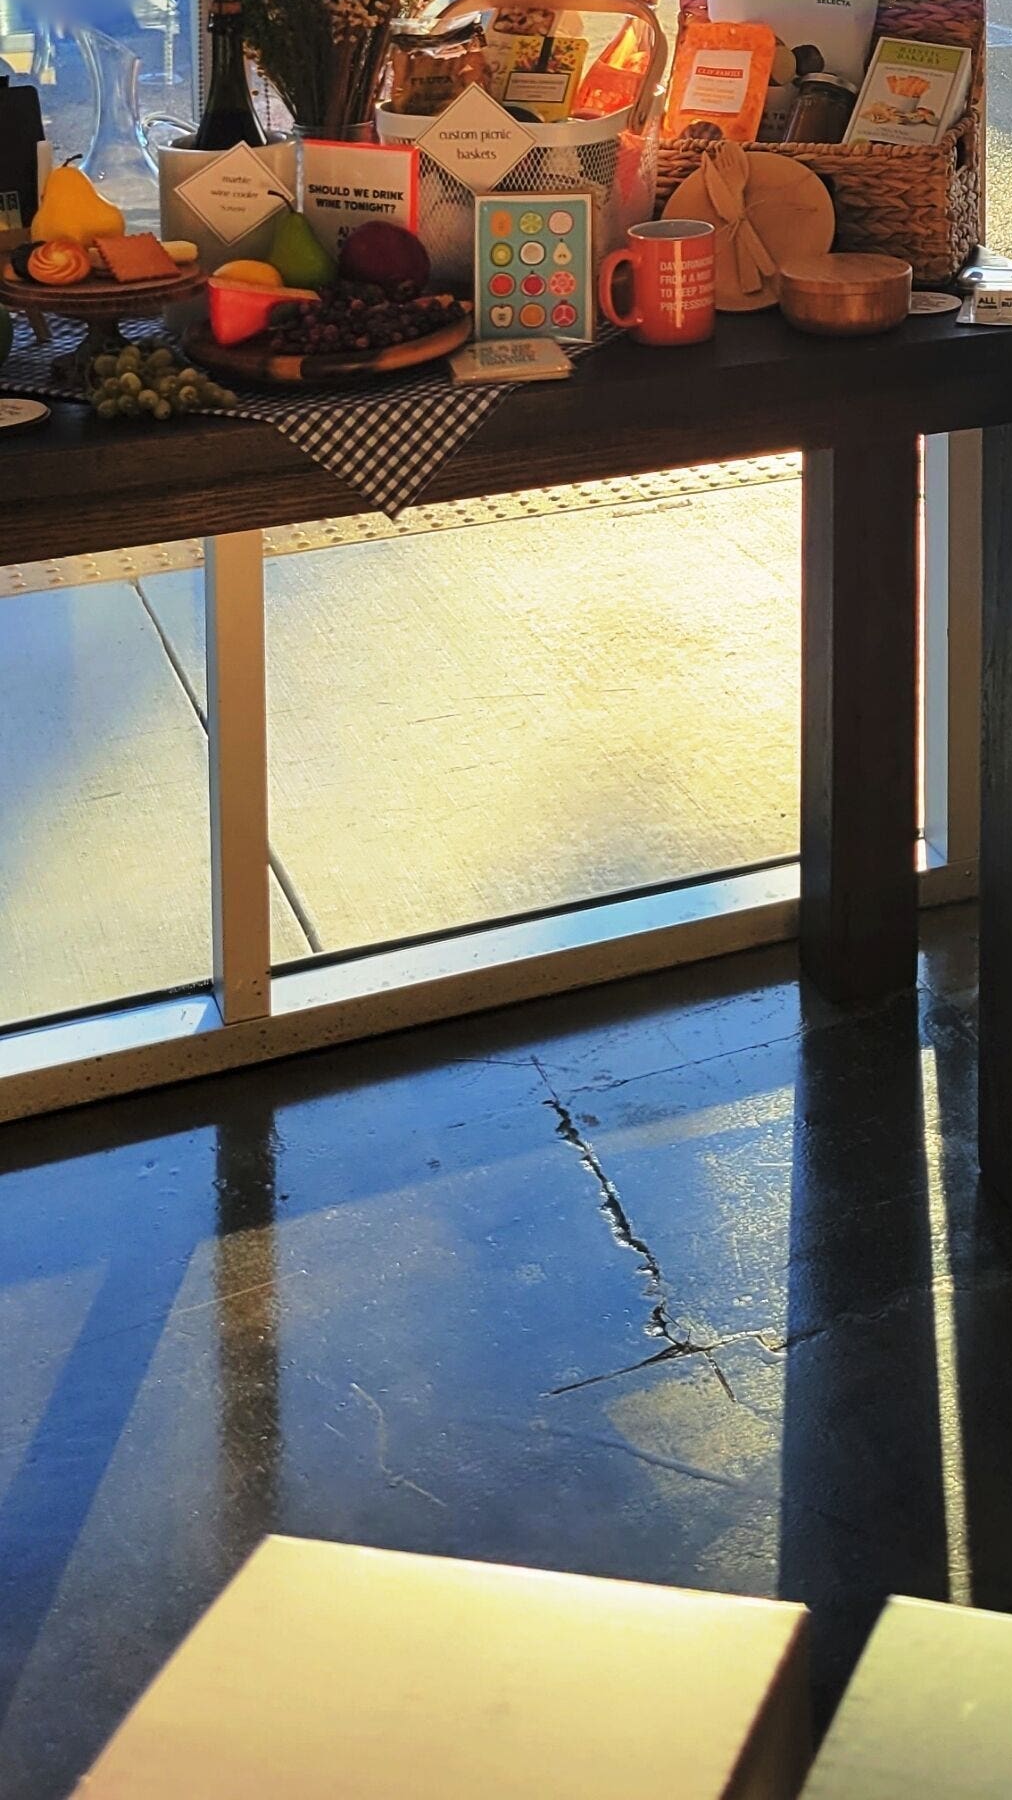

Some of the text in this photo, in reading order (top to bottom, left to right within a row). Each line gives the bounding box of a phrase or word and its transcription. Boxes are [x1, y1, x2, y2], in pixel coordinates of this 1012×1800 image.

[439, 129, 512, 146] custom picnic
[456, 147, 498, 160] baskets
[308, 184, 404, 201] SHOULD WE DRINK
[315, 198, 396, 214] WINE TONIGHT?
[660, 288, 673, 298] TO
[979, 296, 996, 305] ALL
